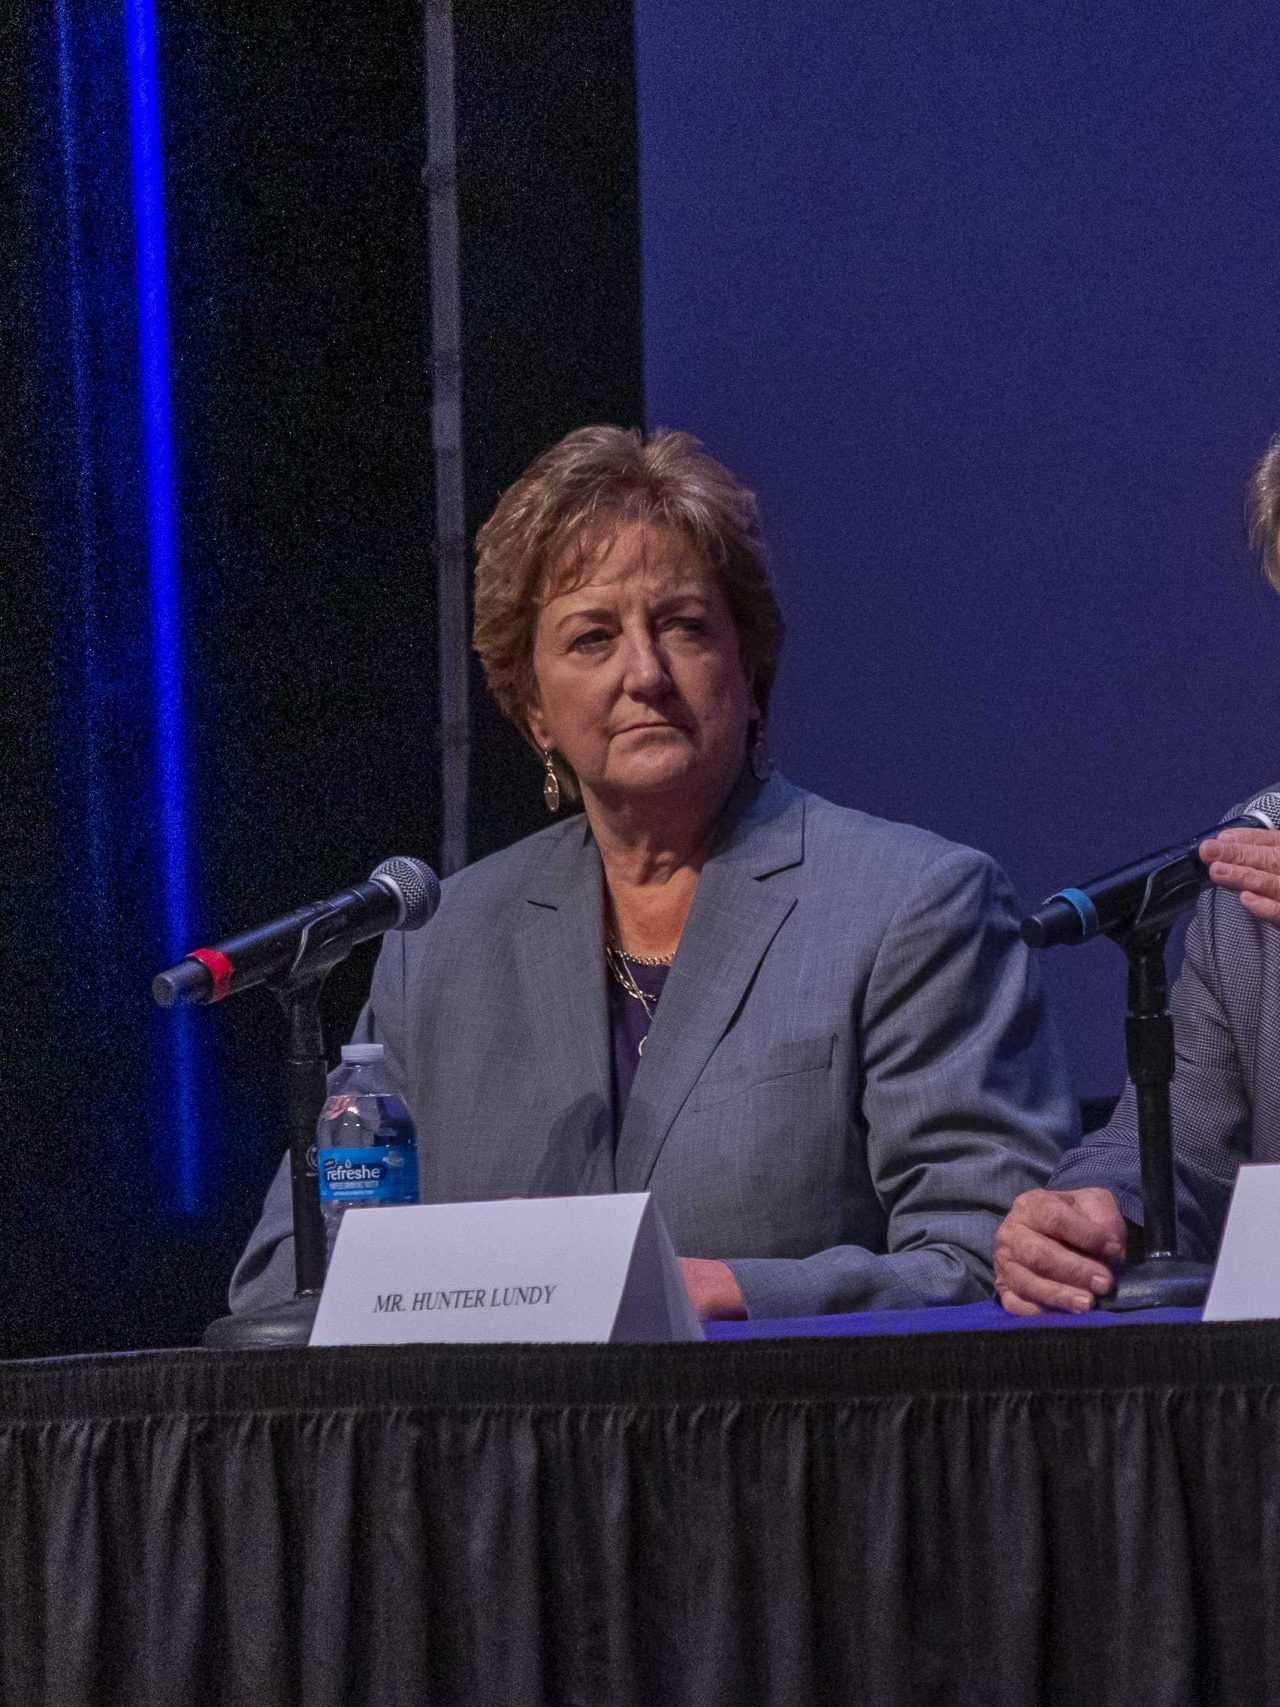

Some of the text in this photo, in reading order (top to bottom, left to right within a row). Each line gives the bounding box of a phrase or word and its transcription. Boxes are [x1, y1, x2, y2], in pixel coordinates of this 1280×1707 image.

[326, 1164, 381, 1181] refreshe
[373, 1284, 559, 1314] MR. HUNTER LUNDY
